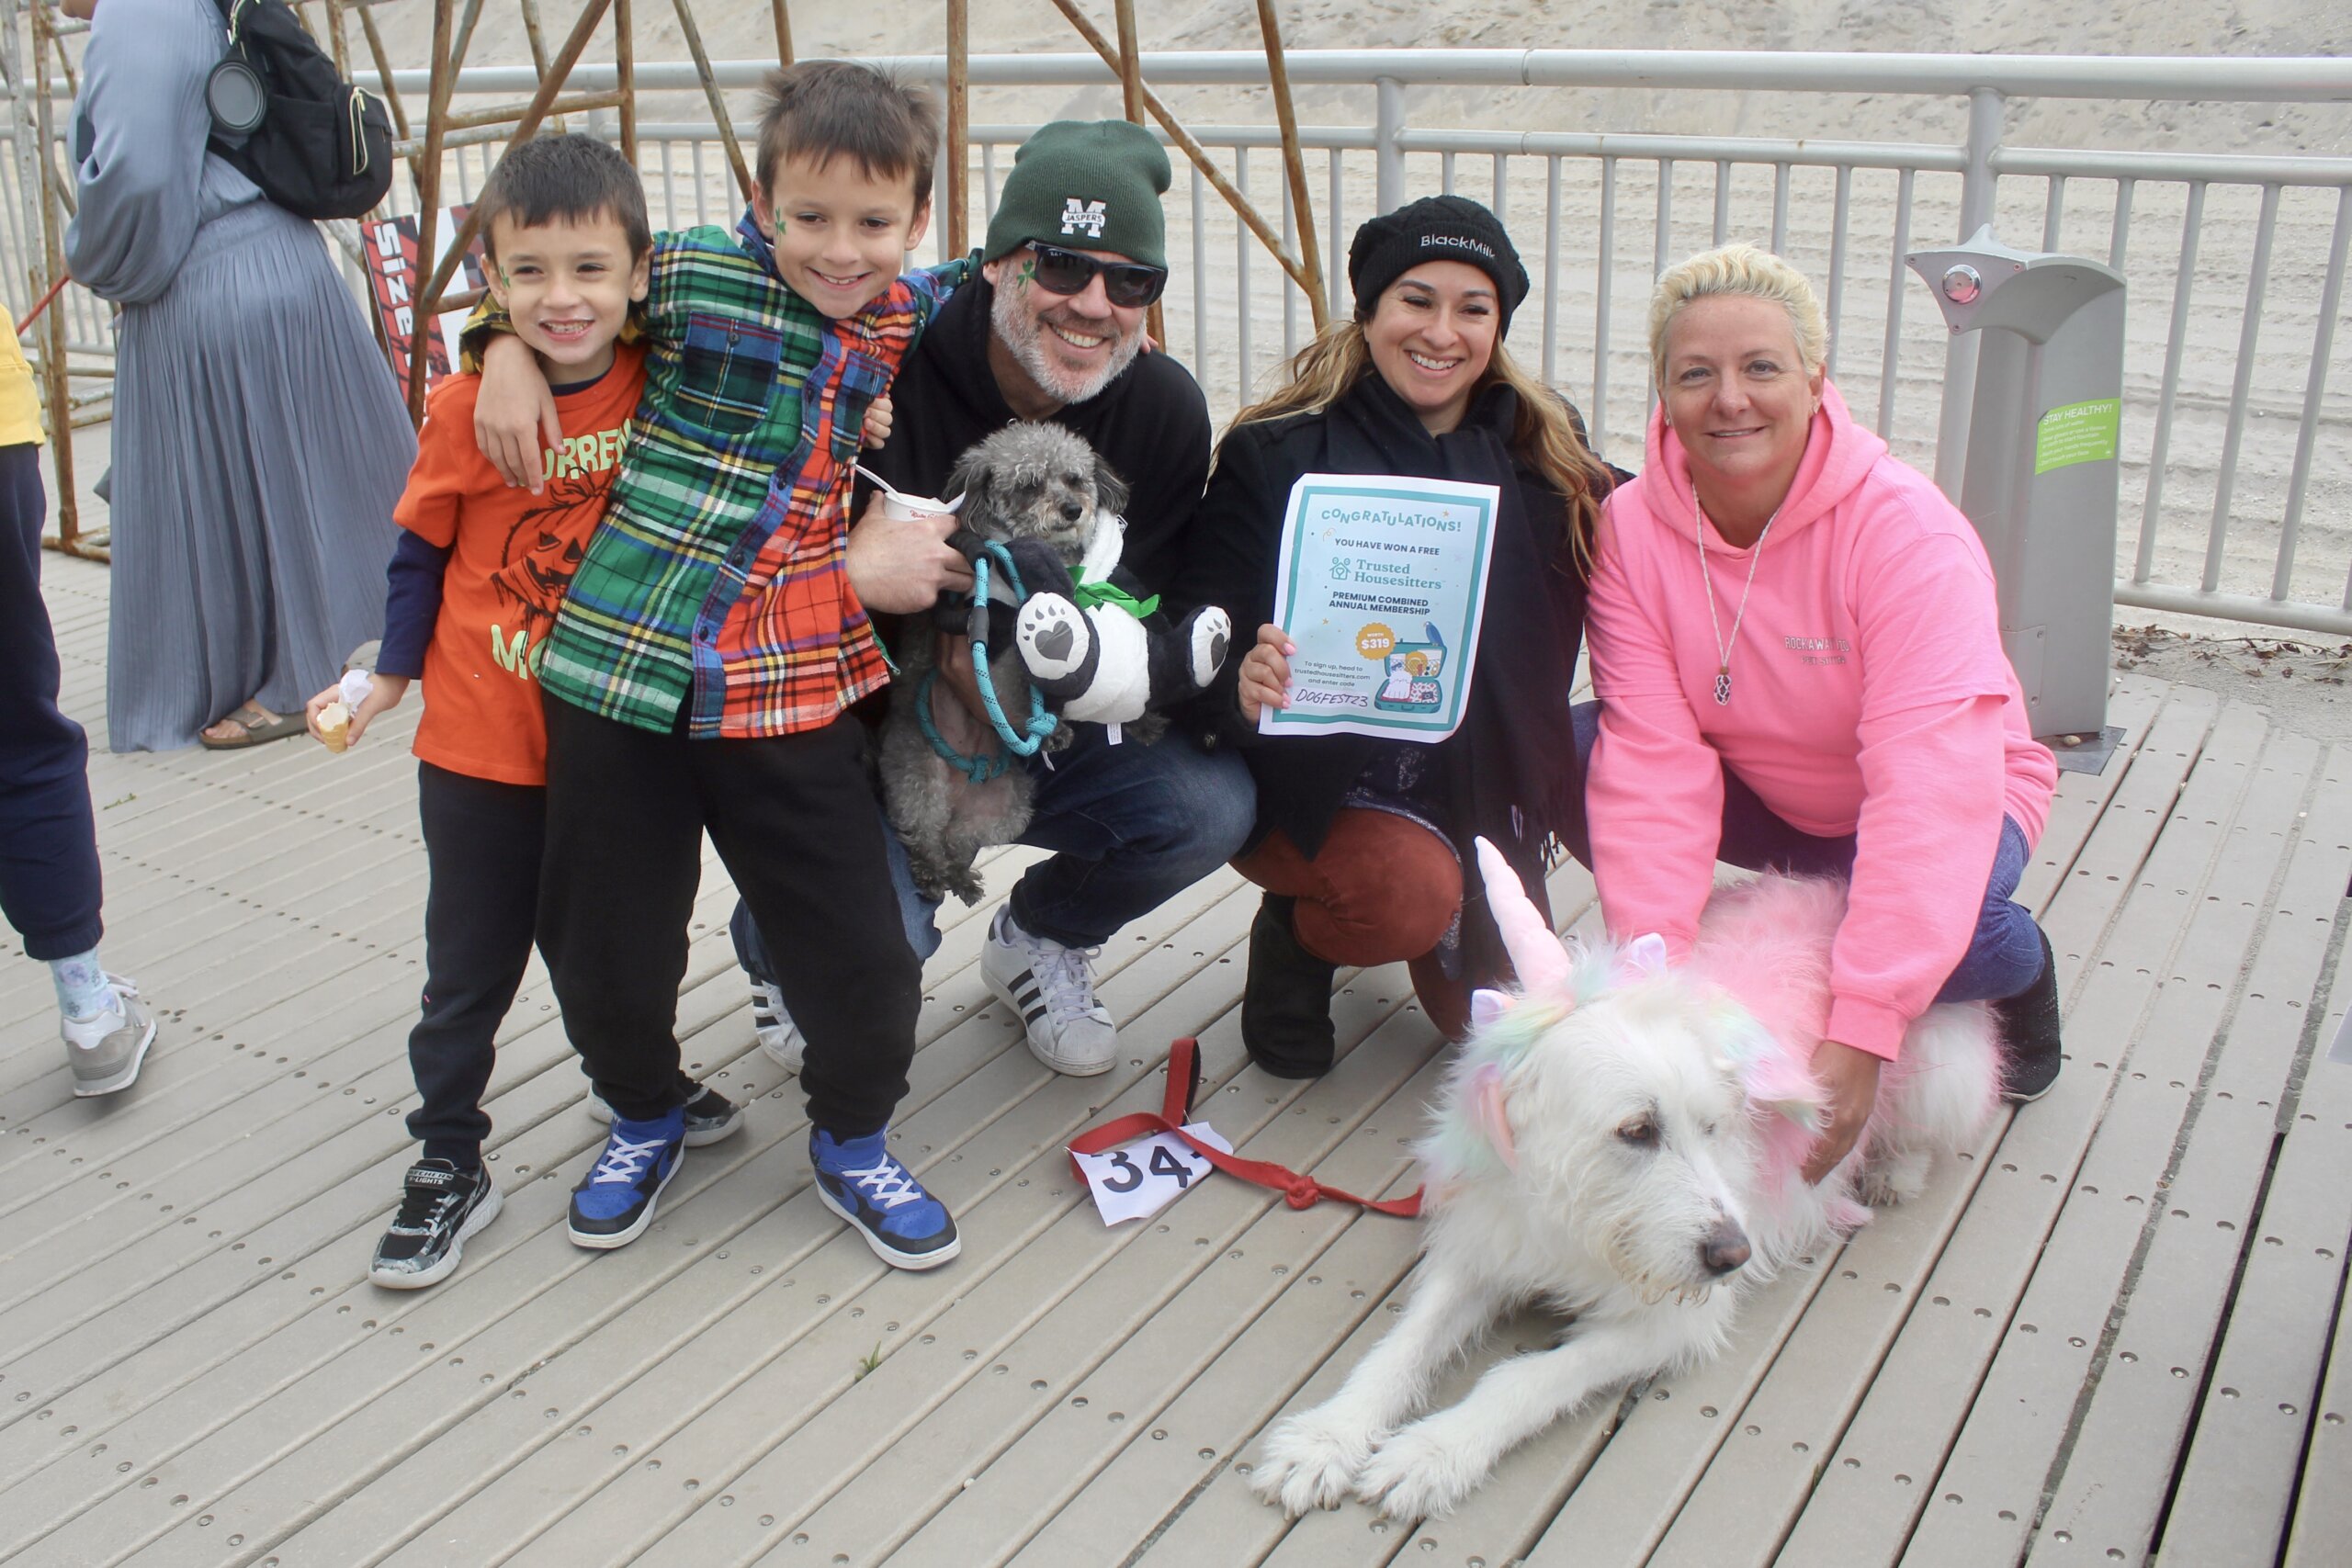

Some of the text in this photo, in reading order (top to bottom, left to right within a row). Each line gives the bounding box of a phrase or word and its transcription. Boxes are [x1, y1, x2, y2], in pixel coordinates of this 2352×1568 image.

[1067, 214, 1102, 222] JASPERS
[373, 222, 413, 337] Size
[2042, 404, 2112, 425] STAY HEALTHY!
[1321, 508, 1462, 532] CONGRATULATIONS!
[1335, 538, 1440, 556] YOU HAVE WON A FREE
[1356, 558, 1410, 574] Trusted
[1354, 571, 1442, 590] Housesitters
[1332, 591, 1429, 607] PREMIUM COMBINED
[1329, 600, 1430, 615] ANNUAL MEMBERSHIP
[1362, 638, 1390, 650] $319
[1313, 661, 1327, 670] sign
[1295, 668, 1371, 680] trustedhousesitters.com
[1295, 688, 1368, 707] DOGFEST23
